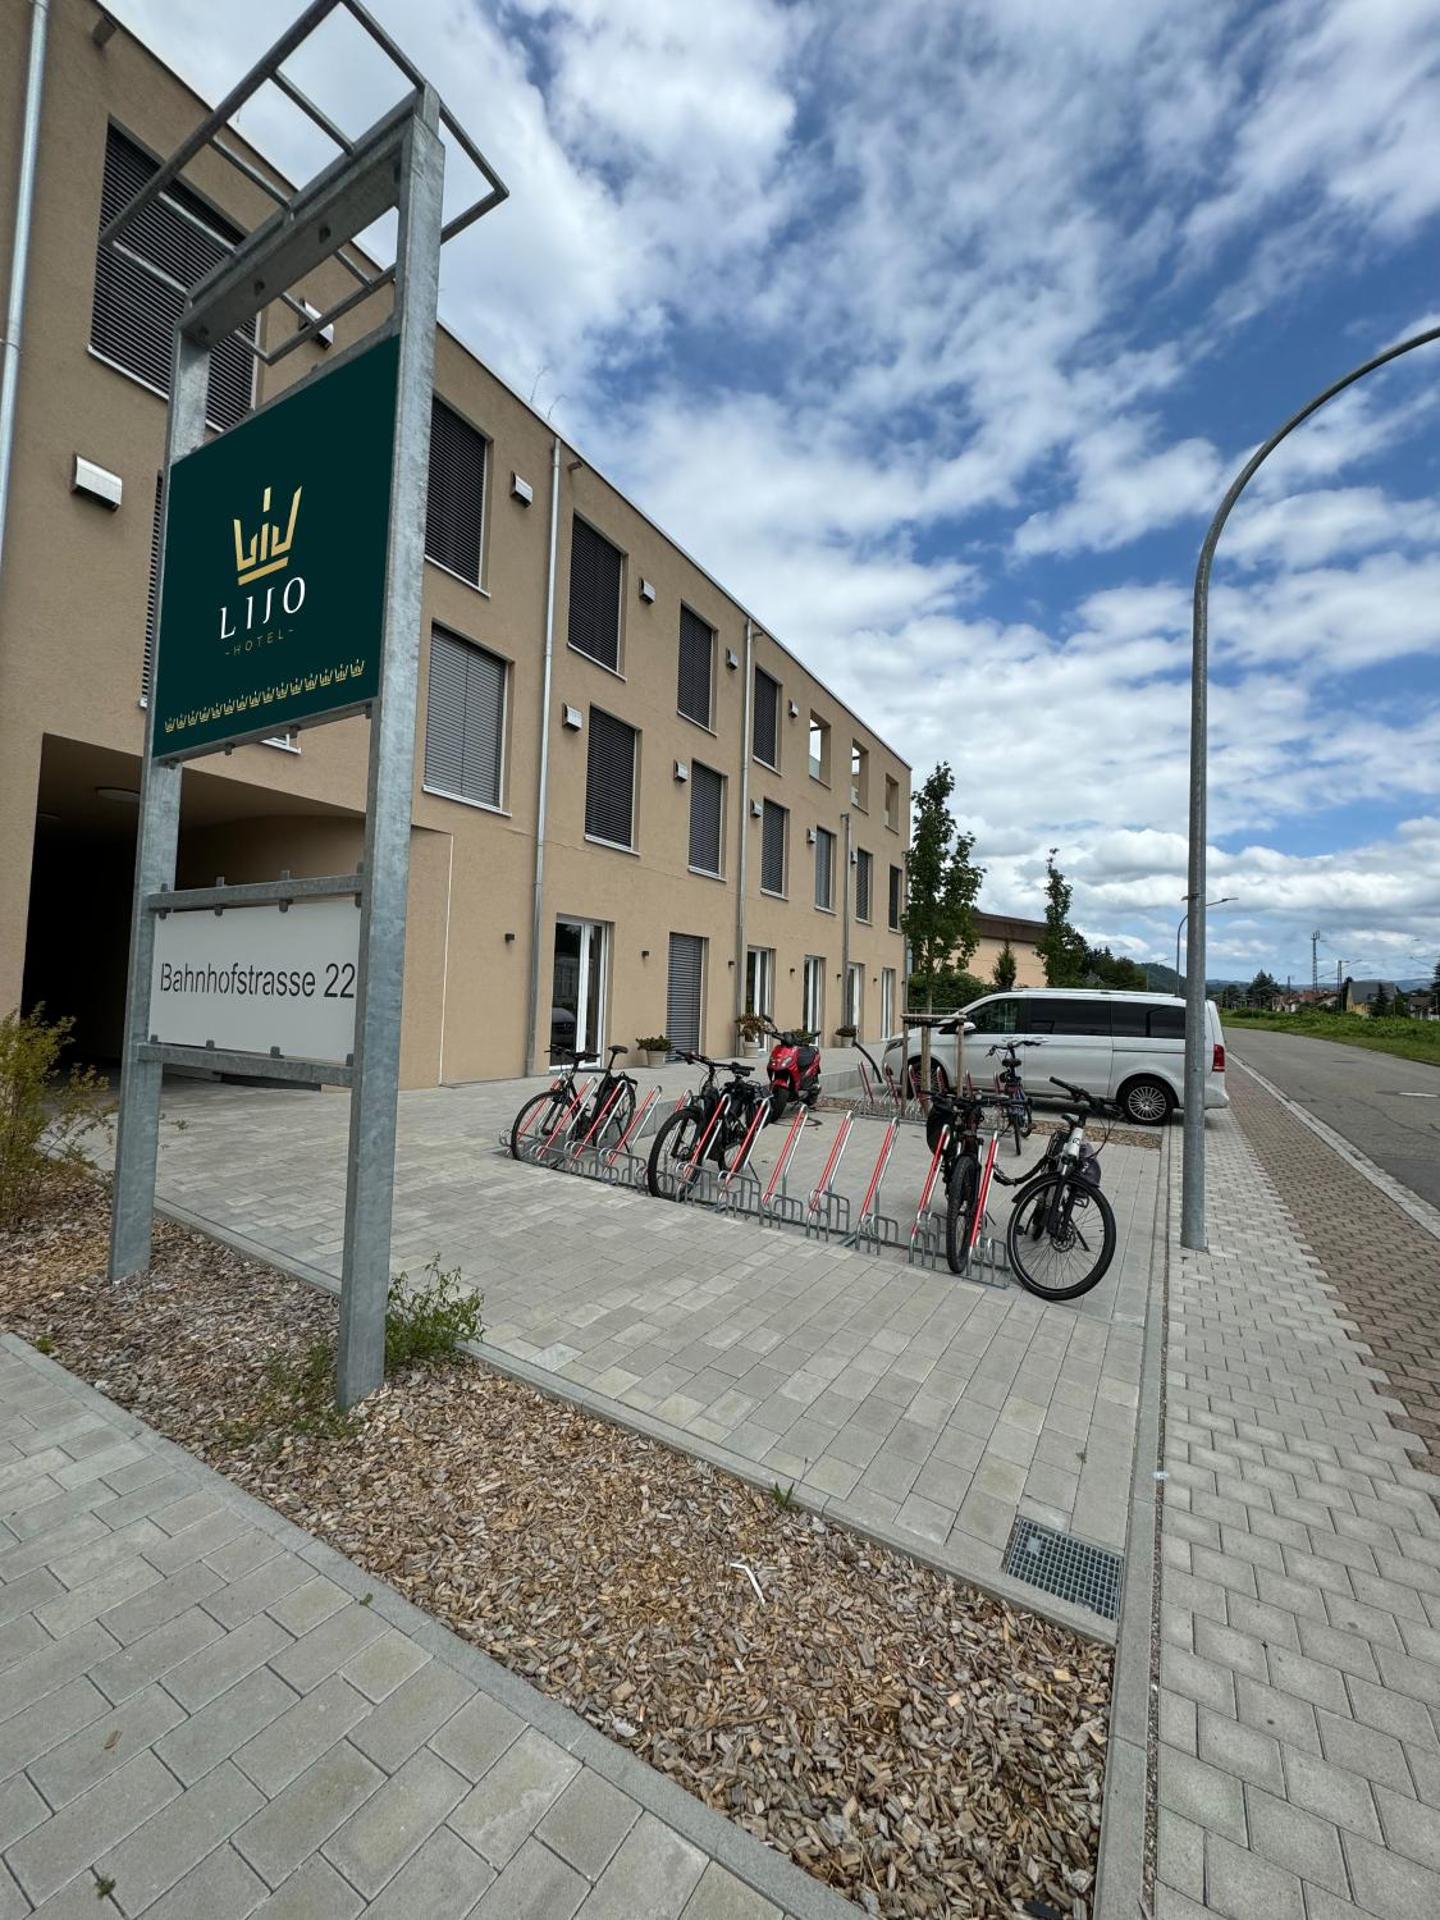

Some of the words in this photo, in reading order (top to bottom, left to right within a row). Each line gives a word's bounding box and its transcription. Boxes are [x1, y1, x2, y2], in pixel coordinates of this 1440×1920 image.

[220, 576, 306, 640] LIJO
[160, 962, 316, 997] Bahnhofstrasse
[323, 963, 356, 998] 22
